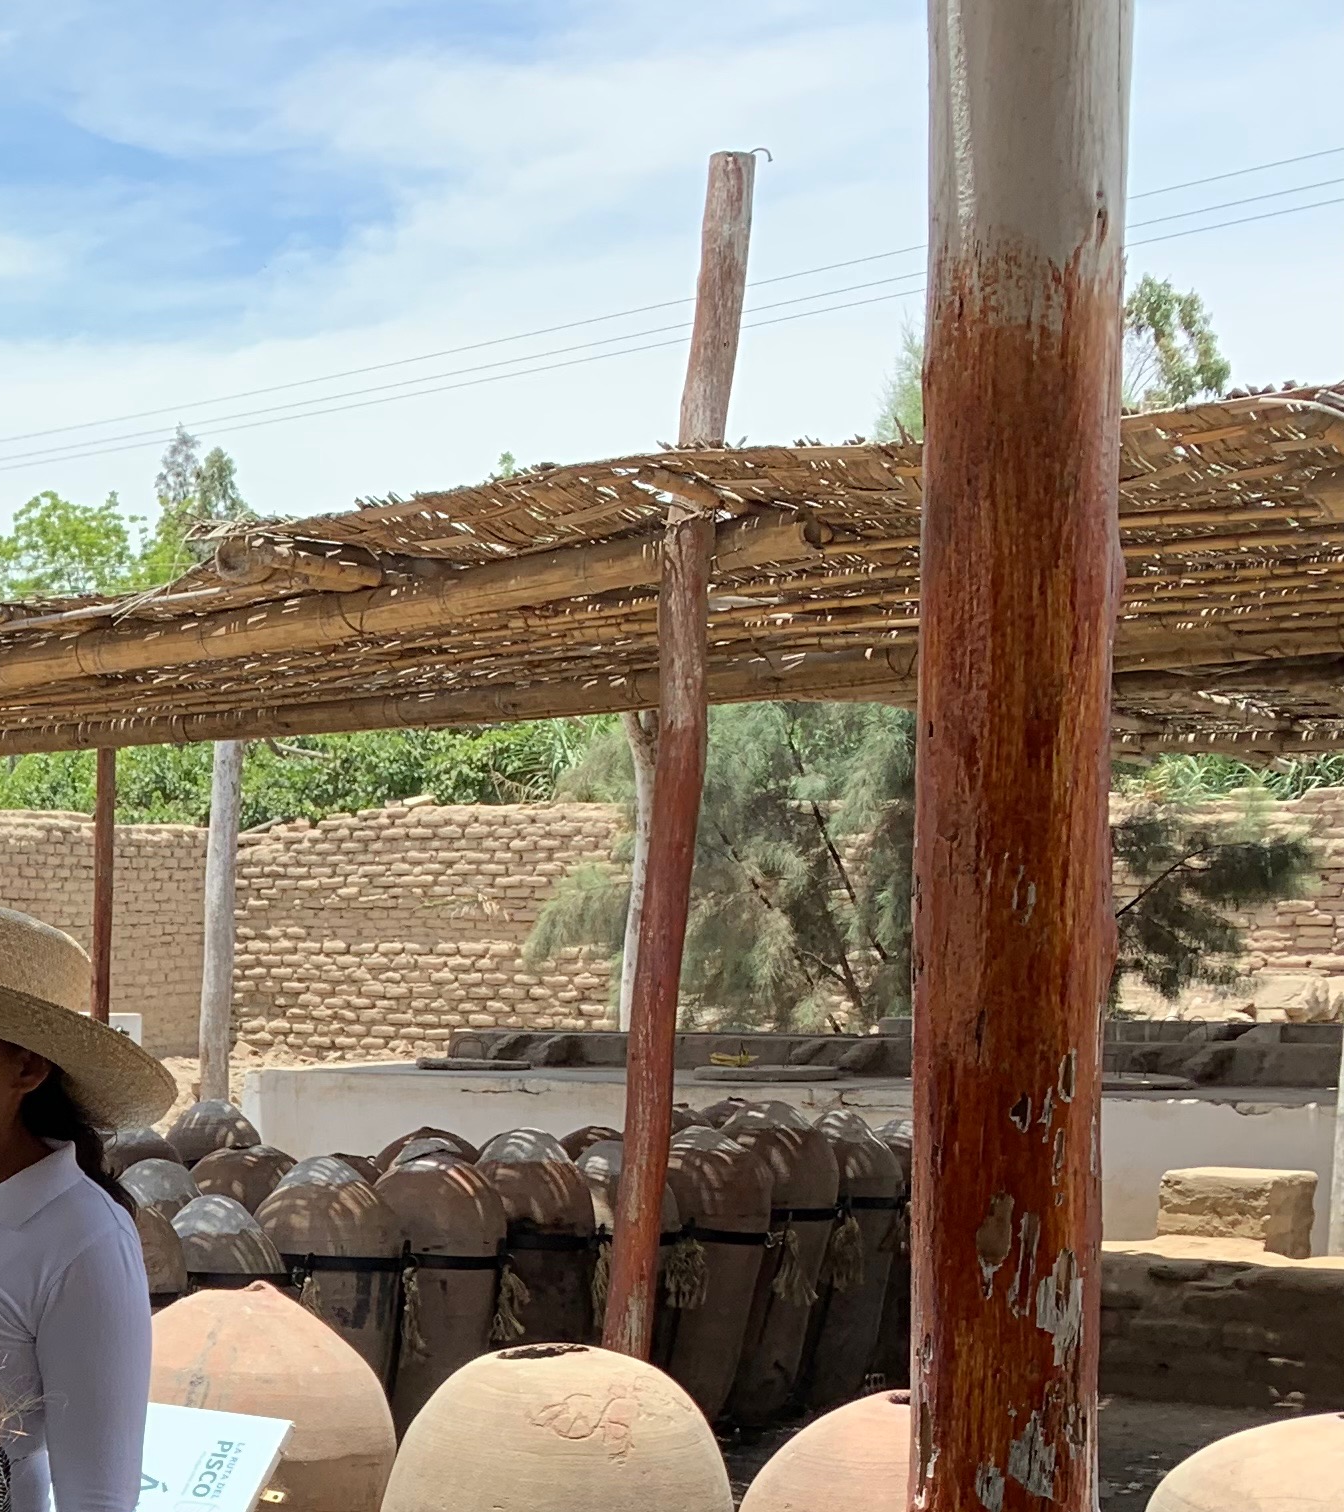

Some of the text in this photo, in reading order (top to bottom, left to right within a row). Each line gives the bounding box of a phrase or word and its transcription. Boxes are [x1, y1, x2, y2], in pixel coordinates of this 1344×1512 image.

[192, 1440, 234, 1498] PISCO
[211, 1441, 246, 1499] LA RUTA DEL
